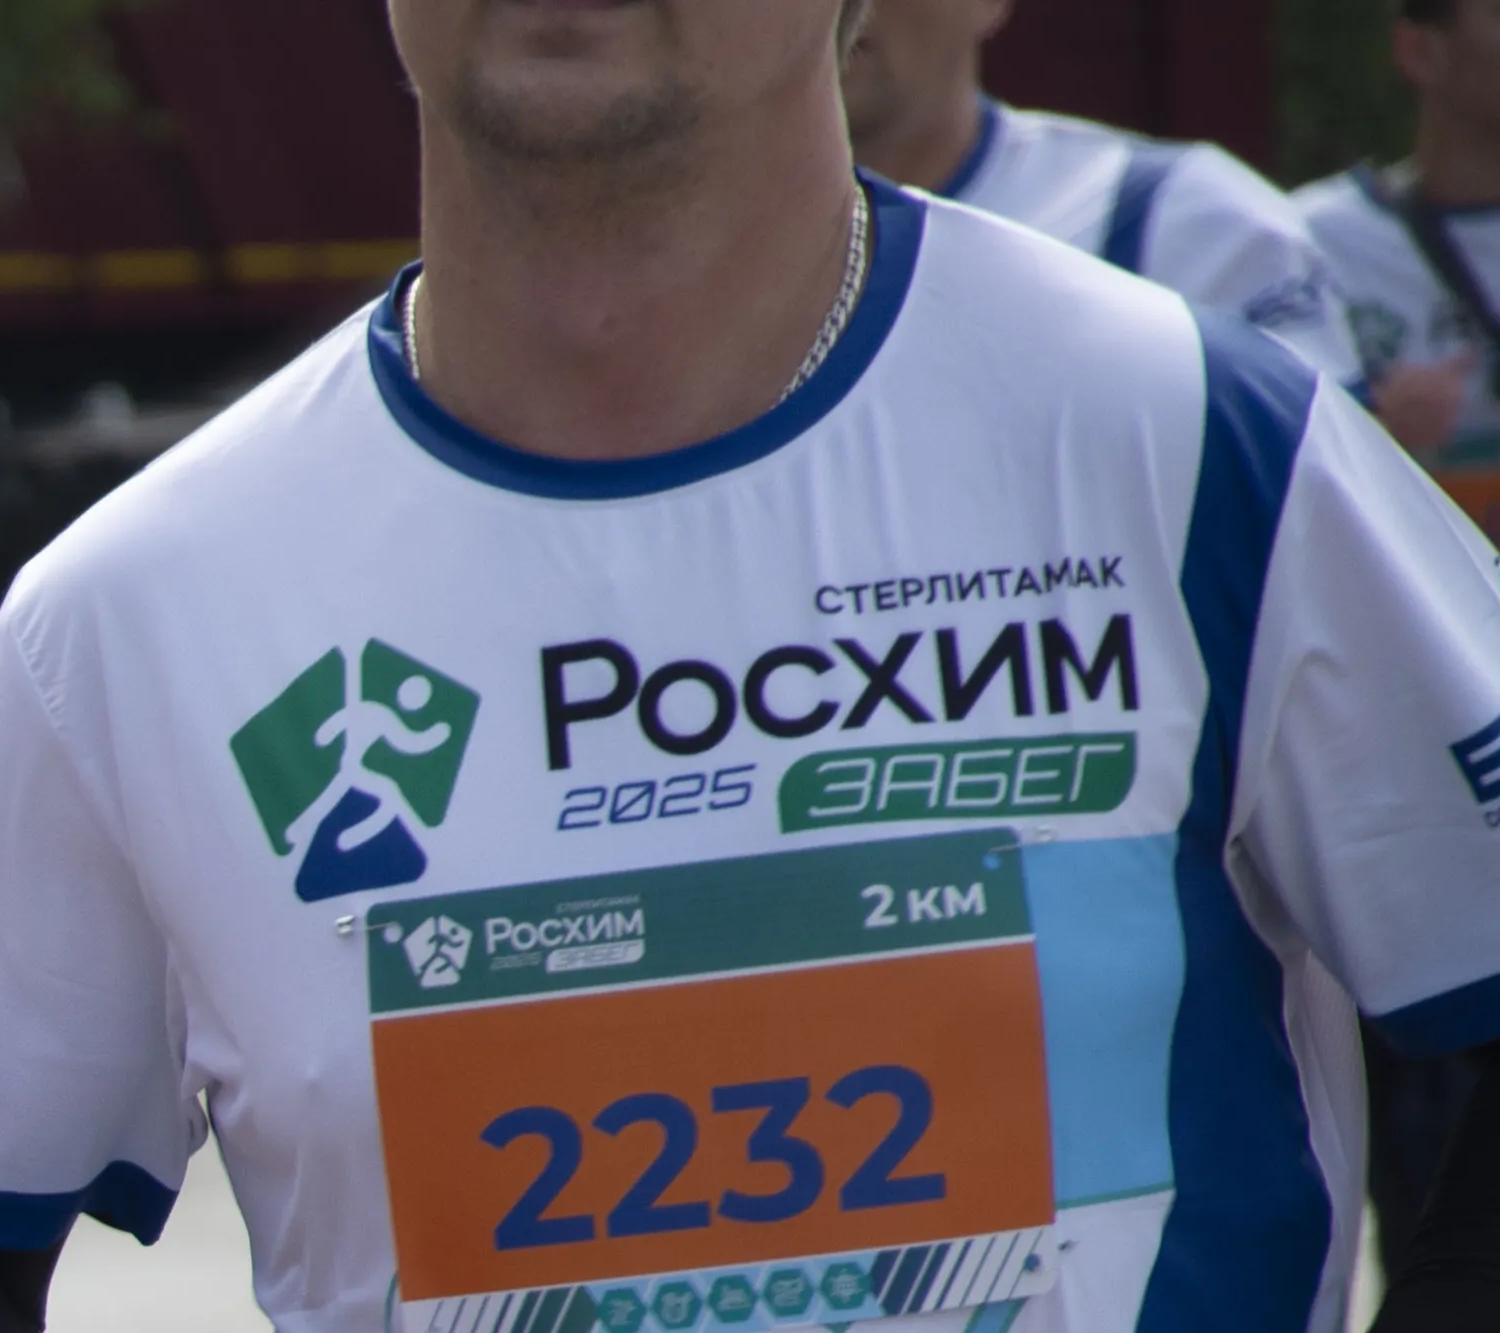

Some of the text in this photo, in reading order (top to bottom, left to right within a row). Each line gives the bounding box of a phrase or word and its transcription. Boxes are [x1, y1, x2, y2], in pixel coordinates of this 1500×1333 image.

[814, 556, 1125, 616] СТЕРЛИТАМАК
[556, 742, 1127, 831] 2025 ЗАБЕГ
[860, 883, 899, 929] 2
[478, 1063, 948, 1252] 2232
